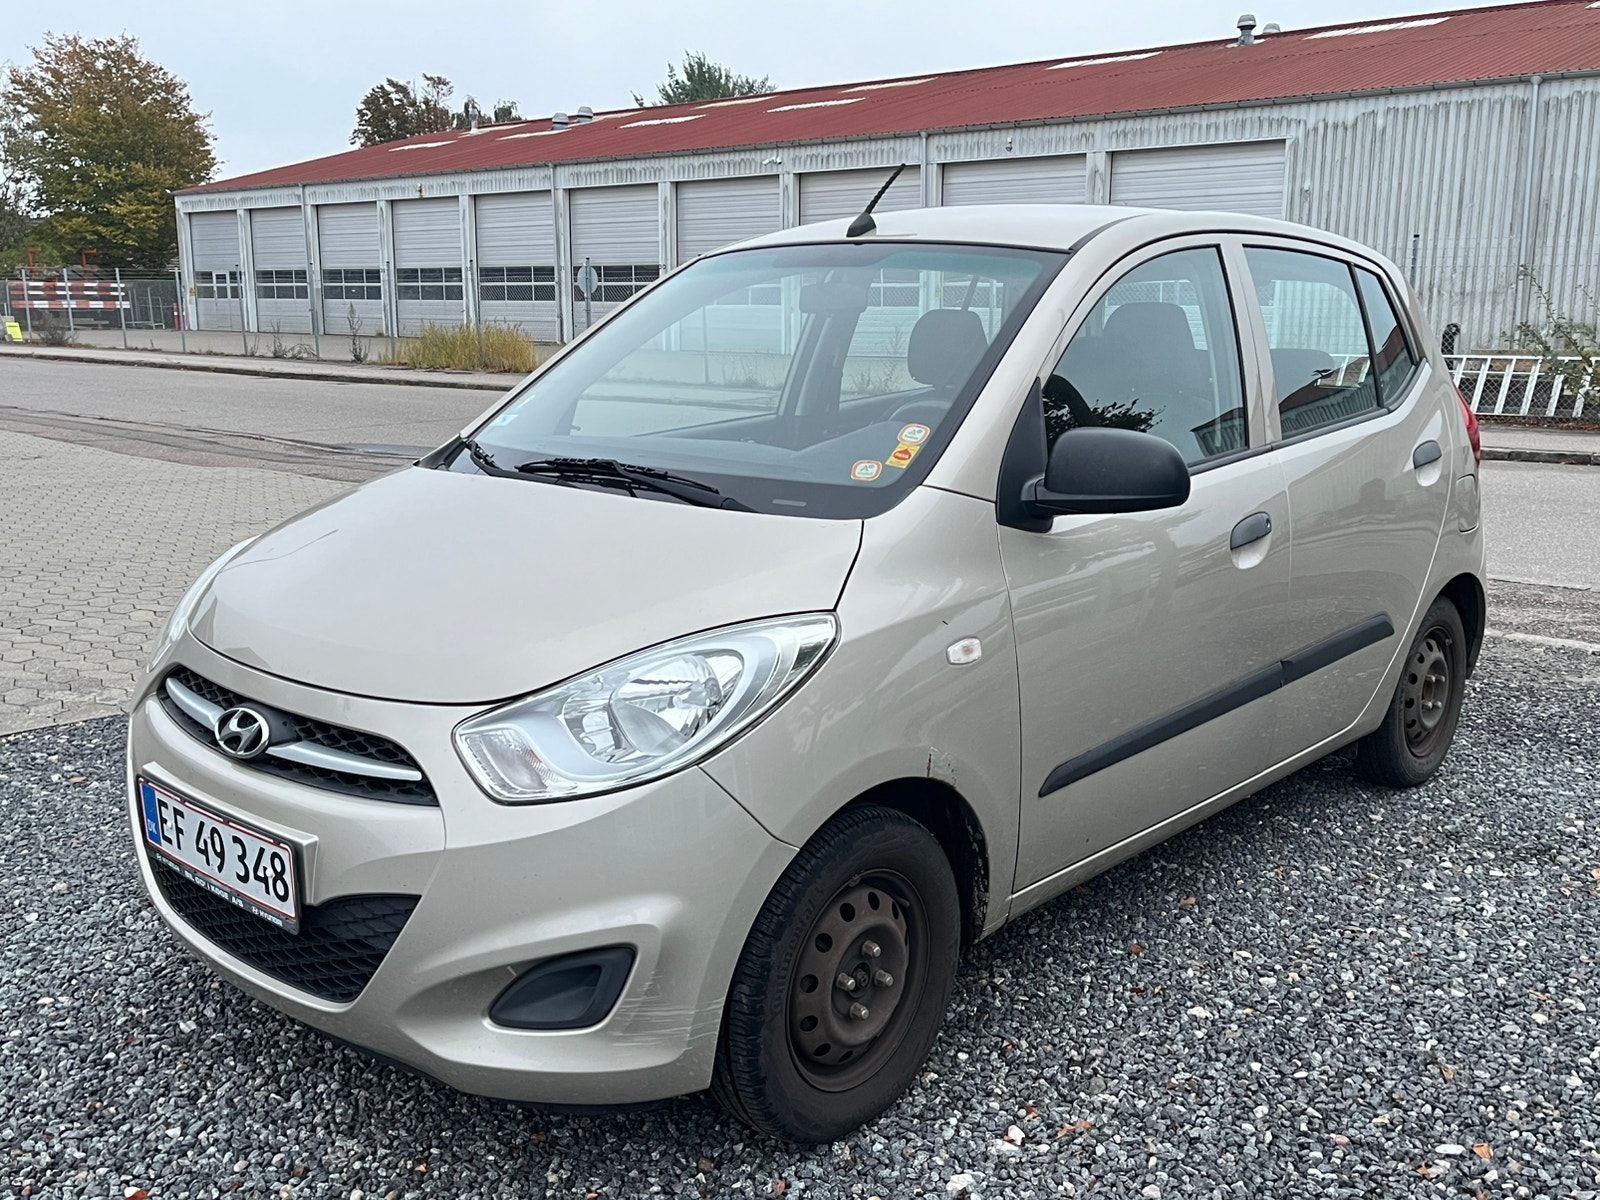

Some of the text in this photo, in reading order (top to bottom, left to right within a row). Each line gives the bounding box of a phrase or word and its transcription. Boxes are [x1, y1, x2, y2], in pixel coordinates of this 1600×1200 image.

[147, 818, 157, 835] DK
[157, 797, 290, 903] EF 49 348
